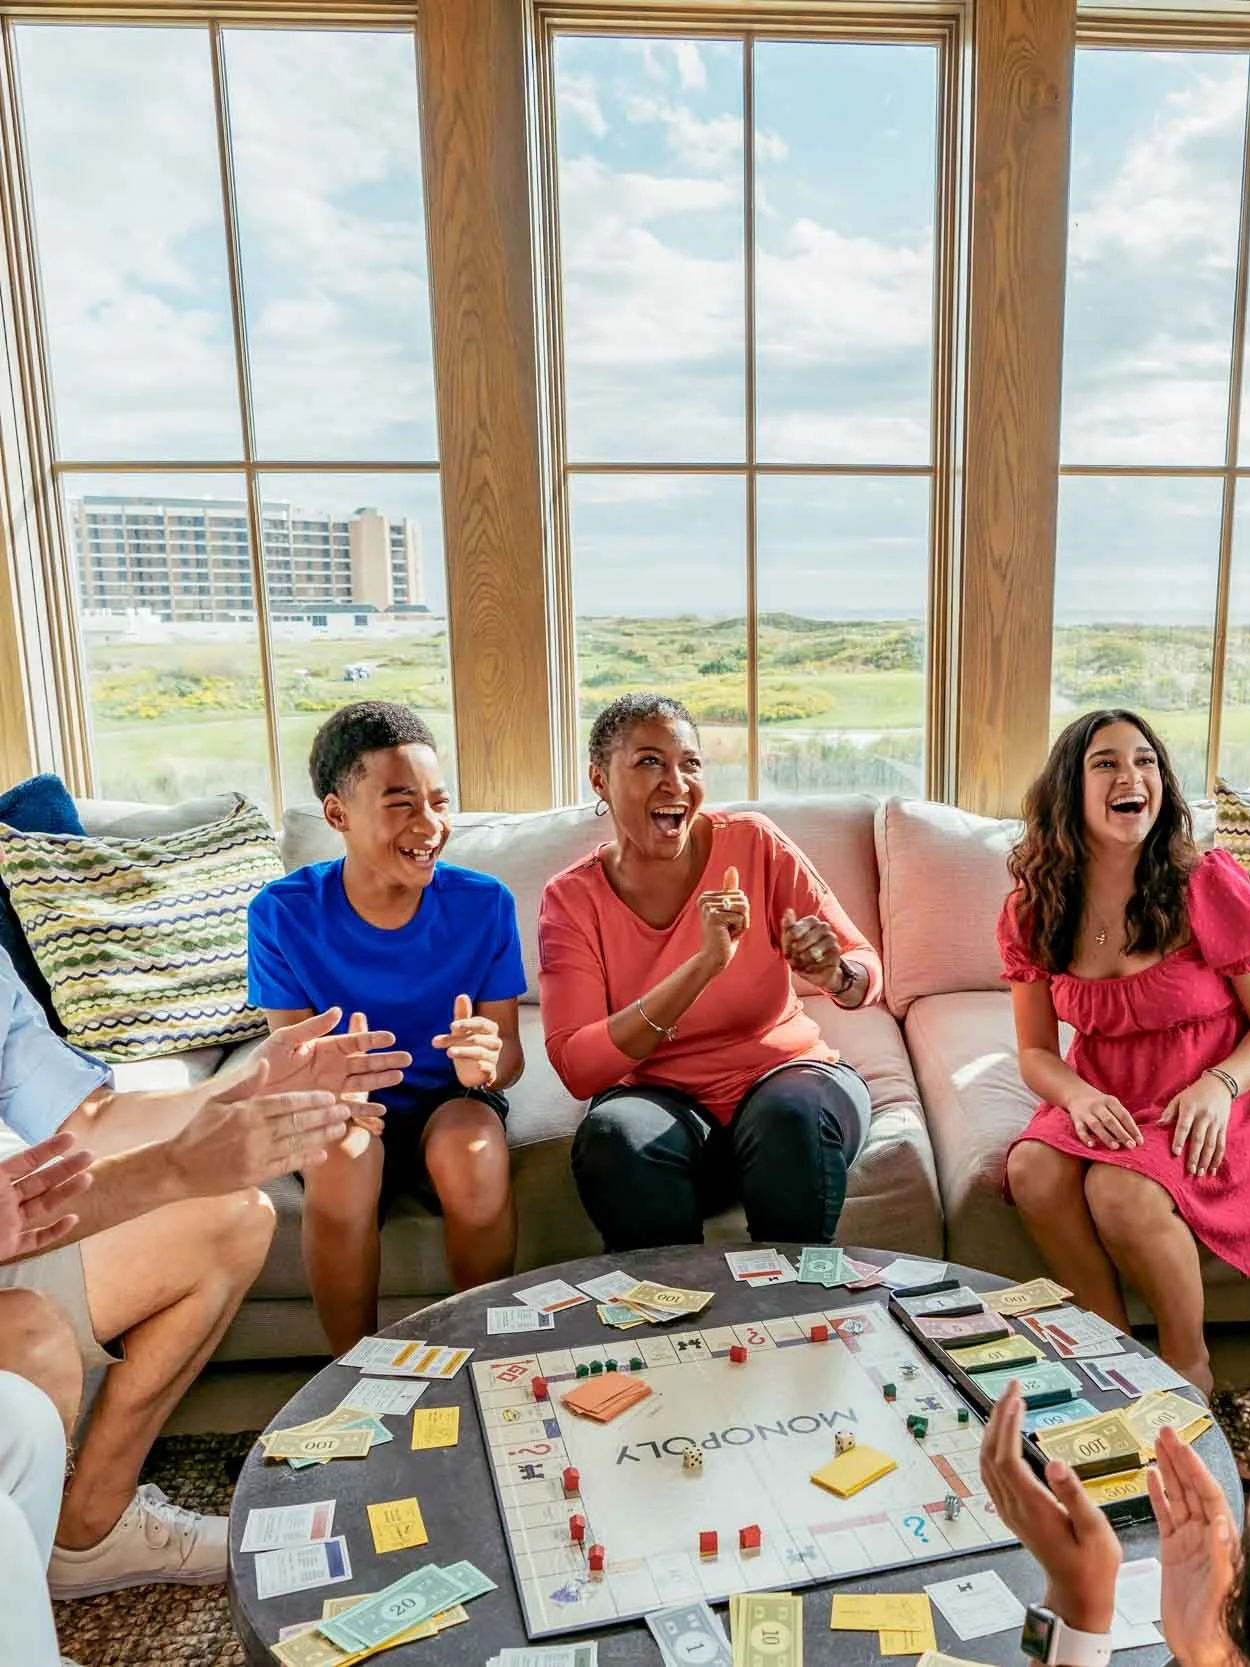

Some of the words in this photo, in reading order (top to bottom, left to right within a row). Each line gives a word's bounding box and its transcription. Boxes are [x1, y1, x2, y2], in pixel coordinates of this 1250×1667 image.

[657, 1294, 681, 1303] 100
[1004, 1295, 1026, 1304] 100
[496, 1364, 529, 1382] GO
[1043, 1415, 1065, 1426] 50
[614, 1407, 860, 1465] MONOPOLY
[304, 1440, 337, 1450] 100
[1079, 1438, 1108, 1457] 100
[1103, 1482, 1138, 1499] 500
[390, 1597, 417, 1616] 20
[761, 1629, 781, 1646] 10
[686, 1643, 705, 1654] 1
